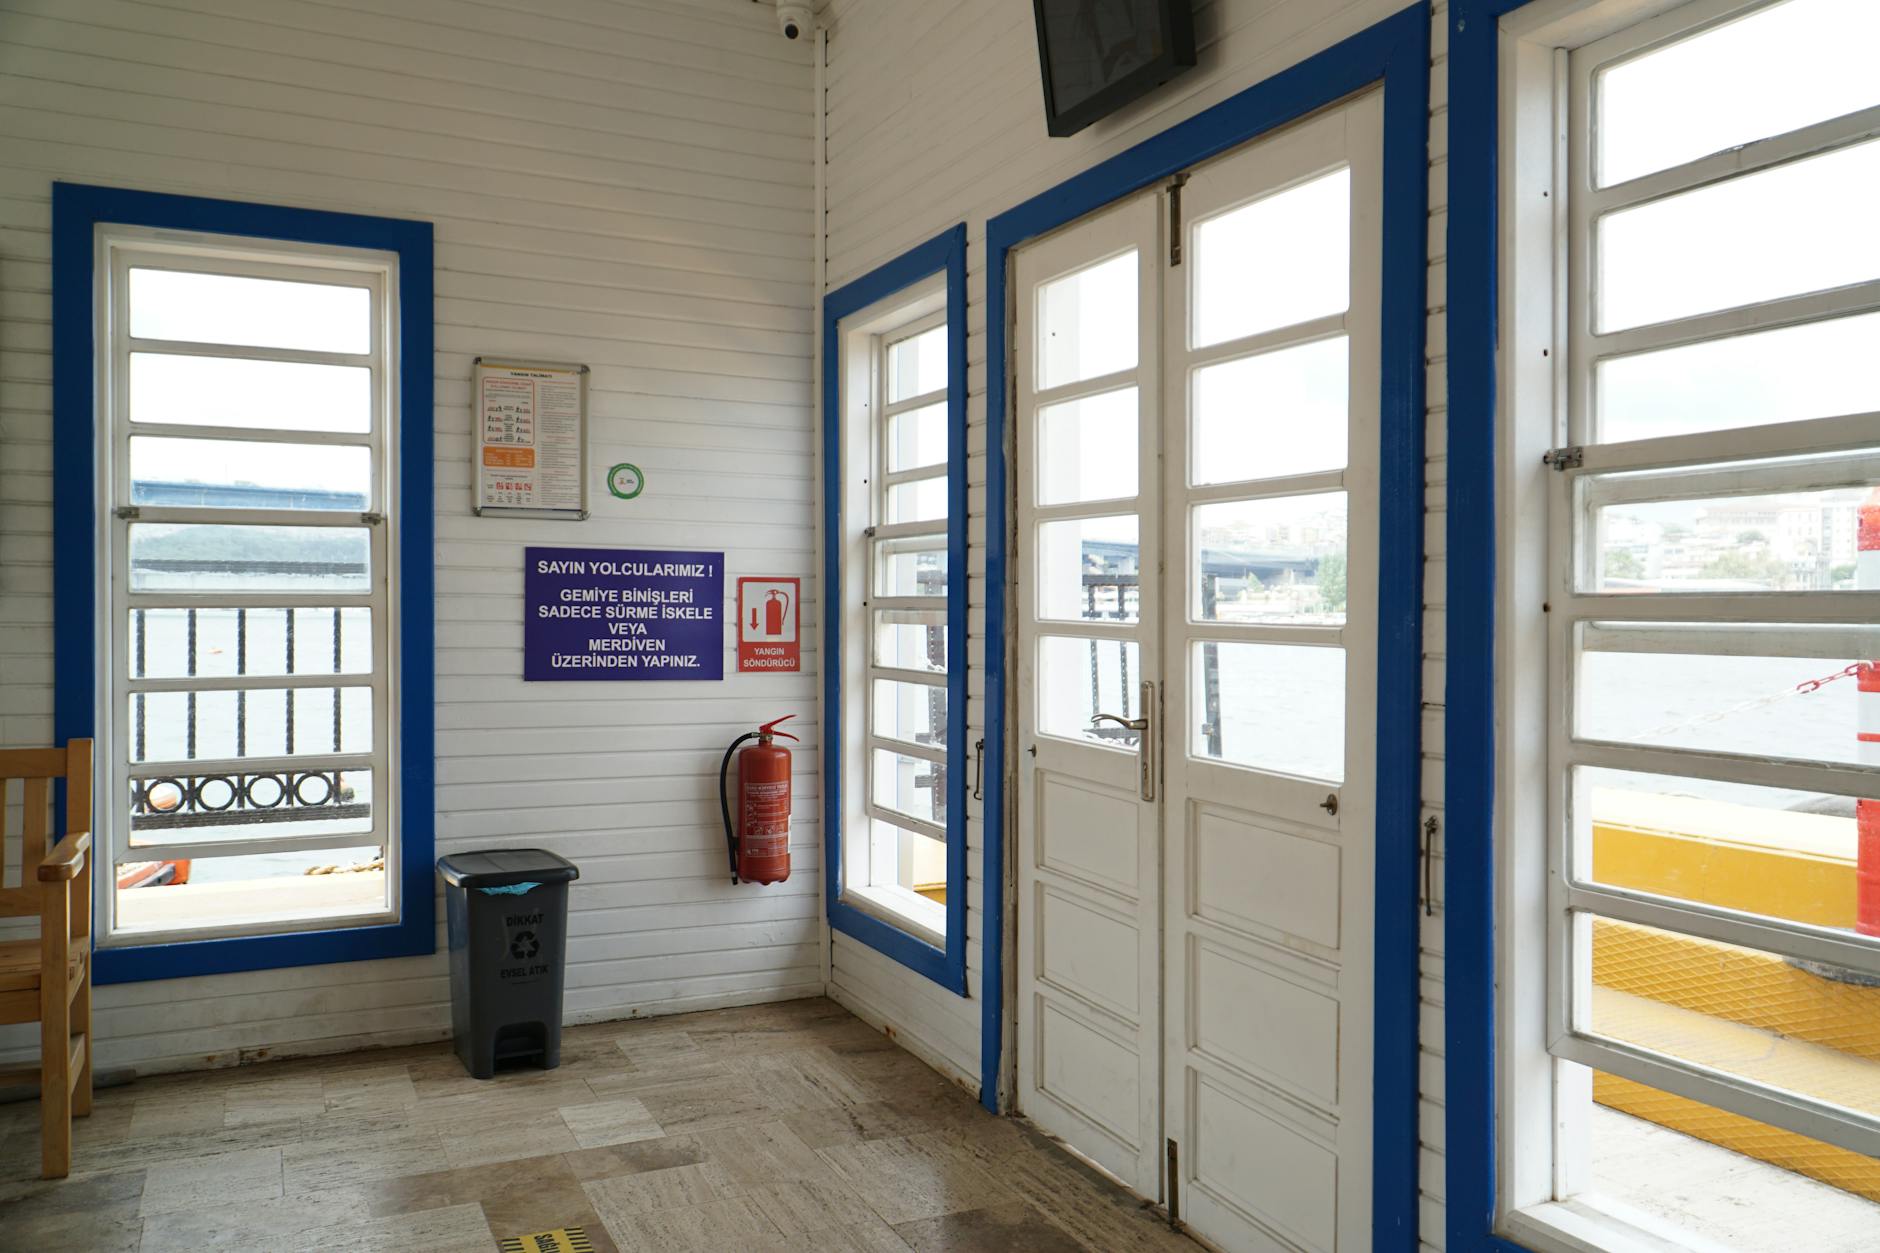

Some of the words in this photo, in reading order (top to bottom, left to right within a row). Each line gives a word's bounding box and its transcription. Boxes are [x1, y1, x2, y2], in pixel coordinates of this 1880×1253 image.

[537, 560, 585, 574] SAYIN
[589, 562, 705, 577] YOLCULARIMIZ
[708, 565, 713, 577] !
[560, 587, 619, 602] GEMİYE
[622, 588, 693, 605] BİNİŞLERİ
[538, 606, 601, 618] SADECE
[605, 604, 658, 619] SÜRME
[662, 605, 713, 620] İSKELE
[608, 622, 647, 635] VEYA
[588, 636, 666, 651] MERDİVEN
[754, 647, 785, 655] YANGIN
[551, 653, 638, 668] ÜZERİNDEN
[641, 655, 700, 668] YAPINIZ.
[743, 657, 796, 668] SÖNDÜRÜCÜ
[501, 968, 526, 979] EVSEL
